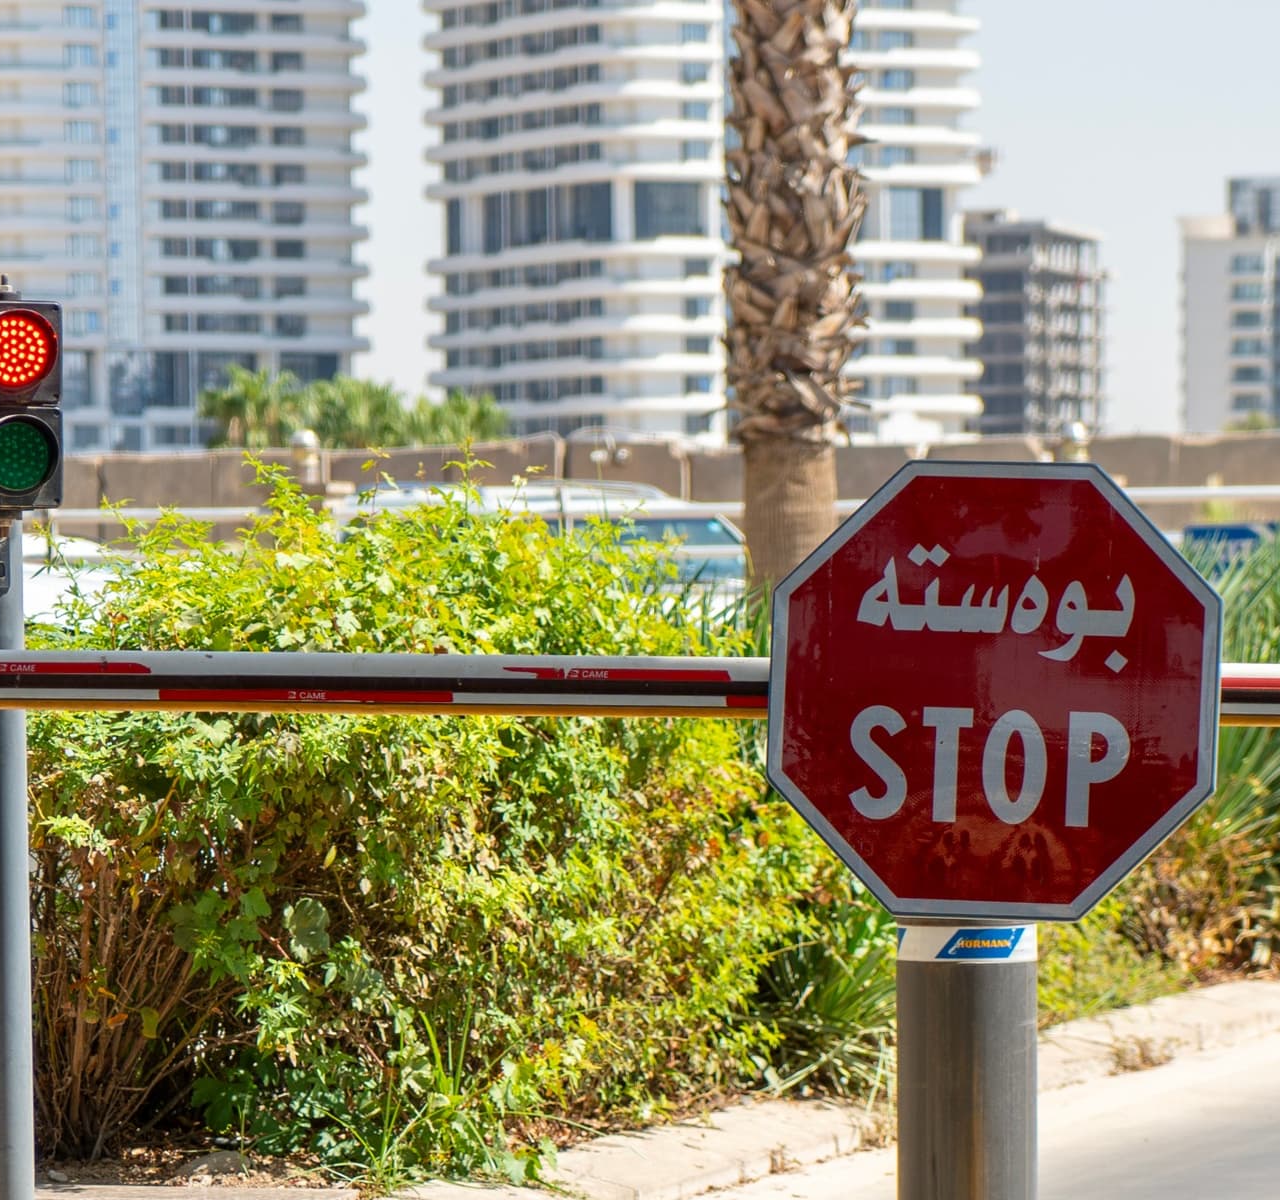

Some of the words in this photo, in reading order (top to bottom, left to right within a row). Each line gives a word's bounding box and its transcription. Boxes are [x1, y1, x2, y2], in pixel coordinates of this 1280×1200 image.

[9, 663, 36, 672] CAME
[582, 670, 609, 679] CAME
[299, 691, 326, 700] CAME
[849, 704, 1132, 828] STOP
